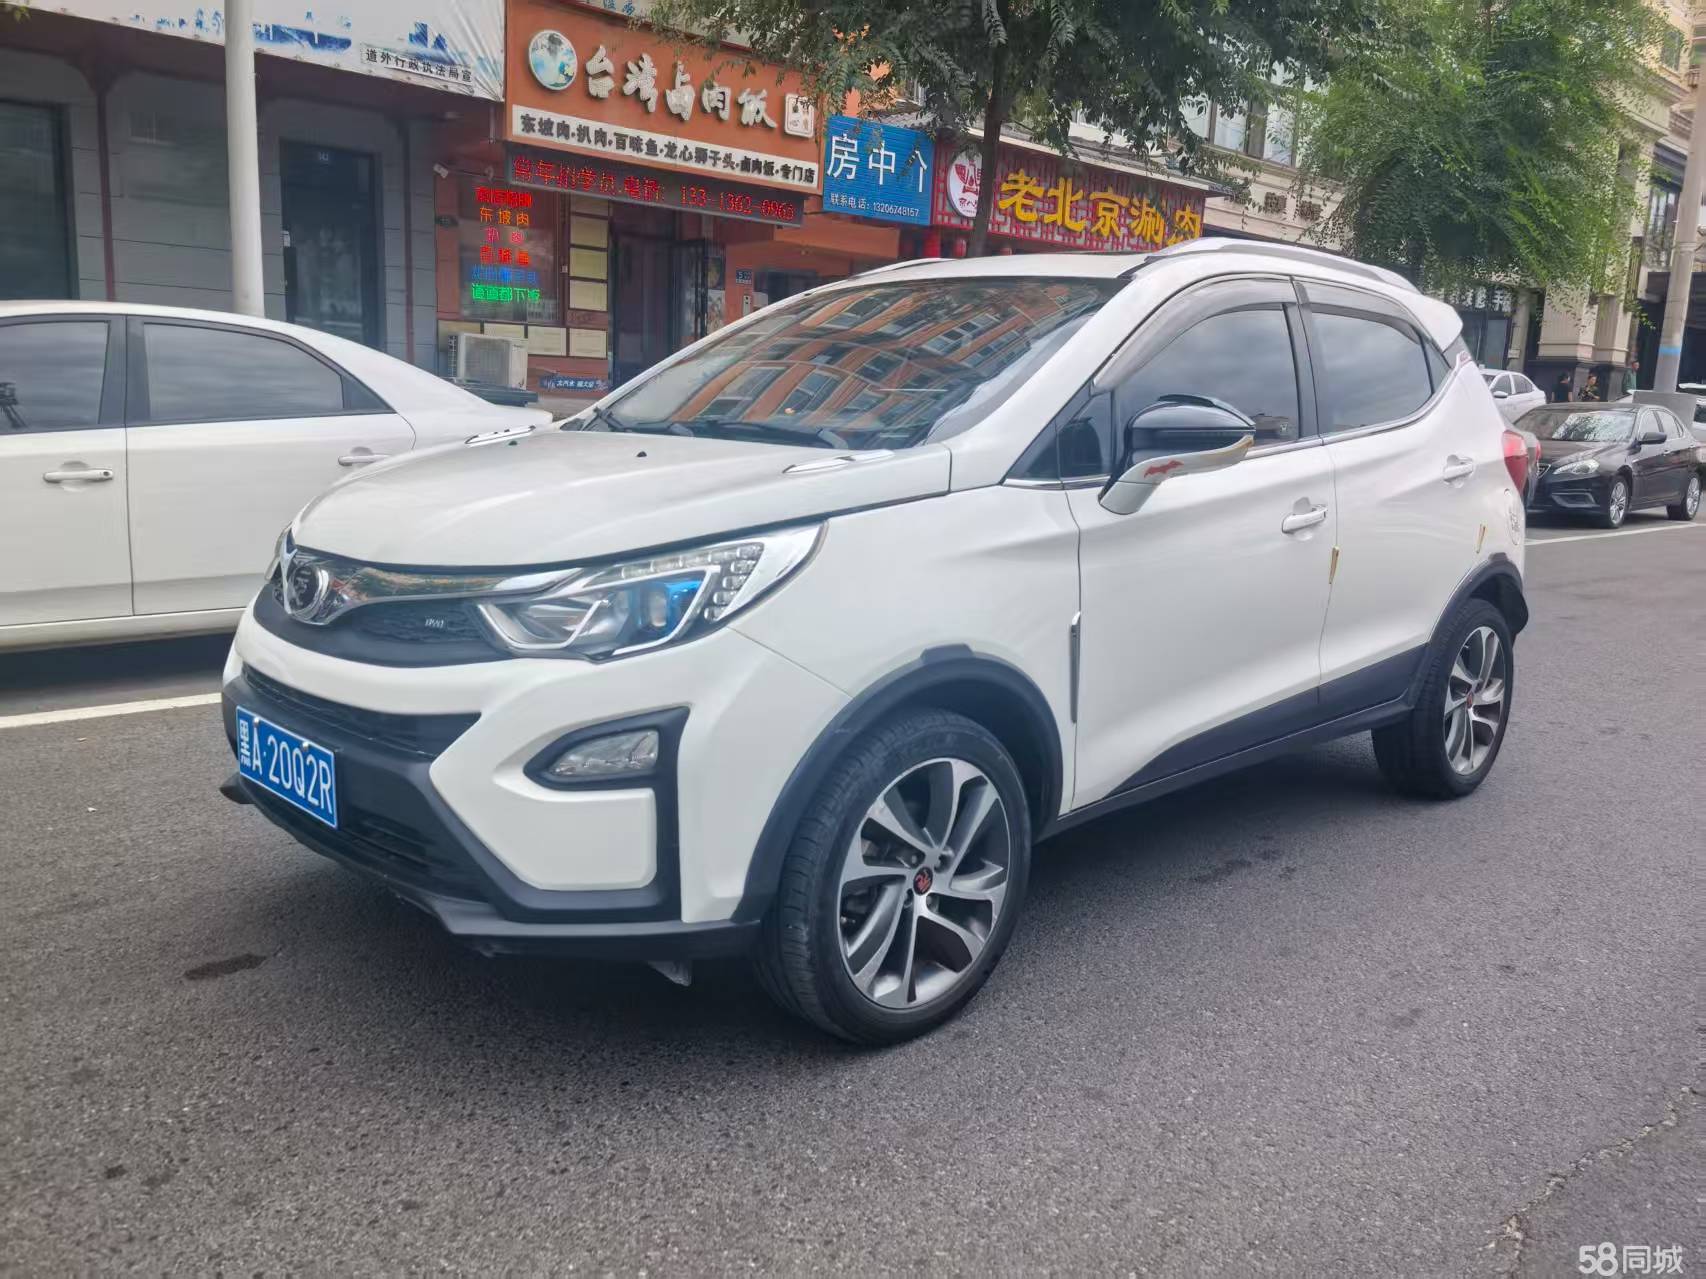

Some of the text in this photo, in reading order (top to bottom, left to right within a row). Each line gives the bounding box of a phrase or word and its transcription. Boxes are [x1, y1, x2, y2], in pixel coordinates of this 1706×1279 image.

[366, 49, 471, 82] 道外行政执法局宣
